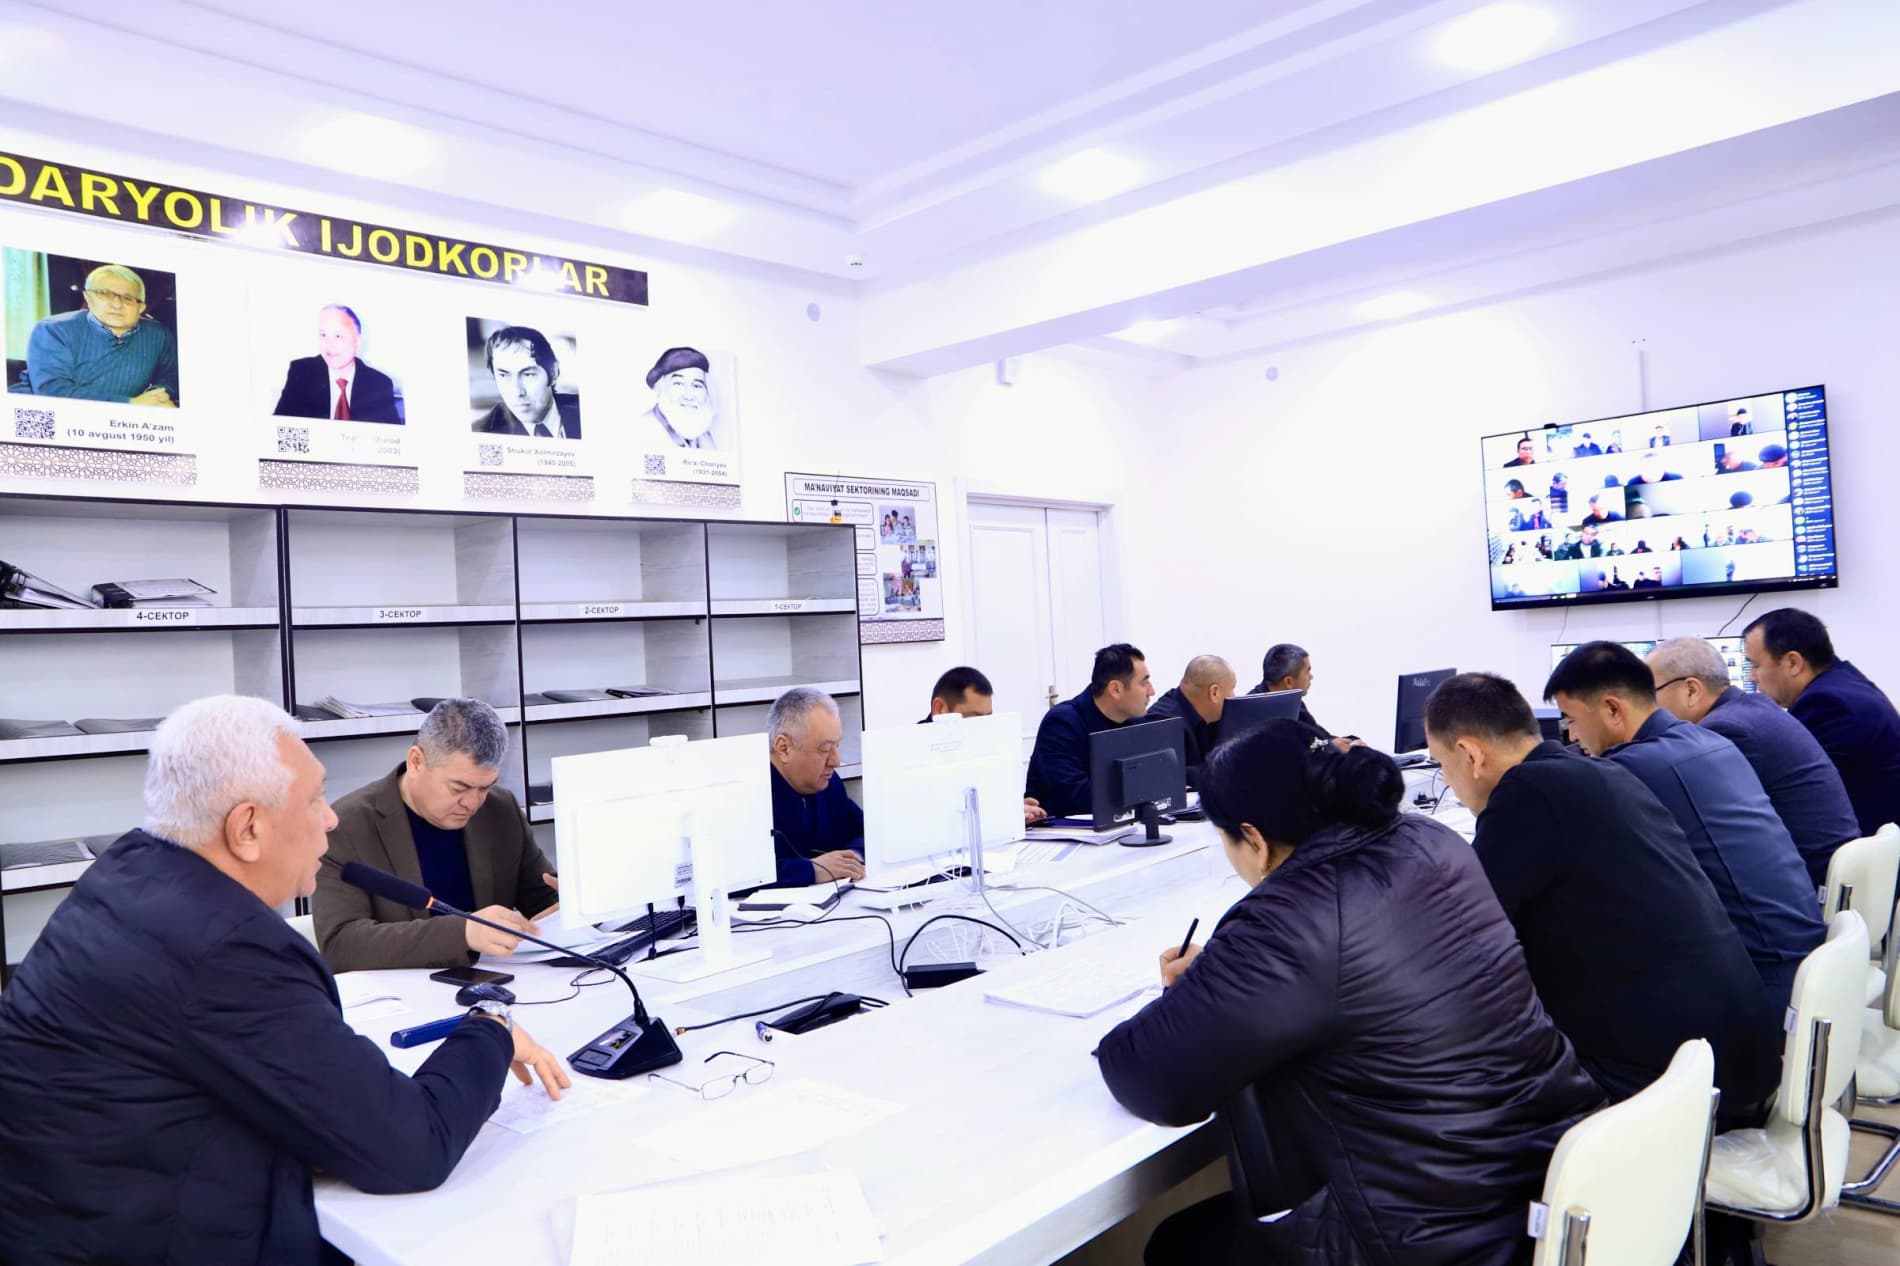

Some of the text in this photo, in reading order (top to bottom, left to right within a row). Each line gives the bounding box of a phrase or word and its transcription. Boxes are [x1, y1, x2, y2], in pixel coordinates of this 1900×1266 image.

[109, 419, 139, 429] Erkin
[67, 429, 175, 444] (10 avgust 1950 yil)
[804, 482, 920, 497] MA'NAVIYAT SEKTORINING MAQSADI
[379, 610, 422, 618] 3-СЕКТОР
[584, 606, 620, 615] 2-СЕКТОР
[136, 611, 190, 620] 4-СЕКТОР
